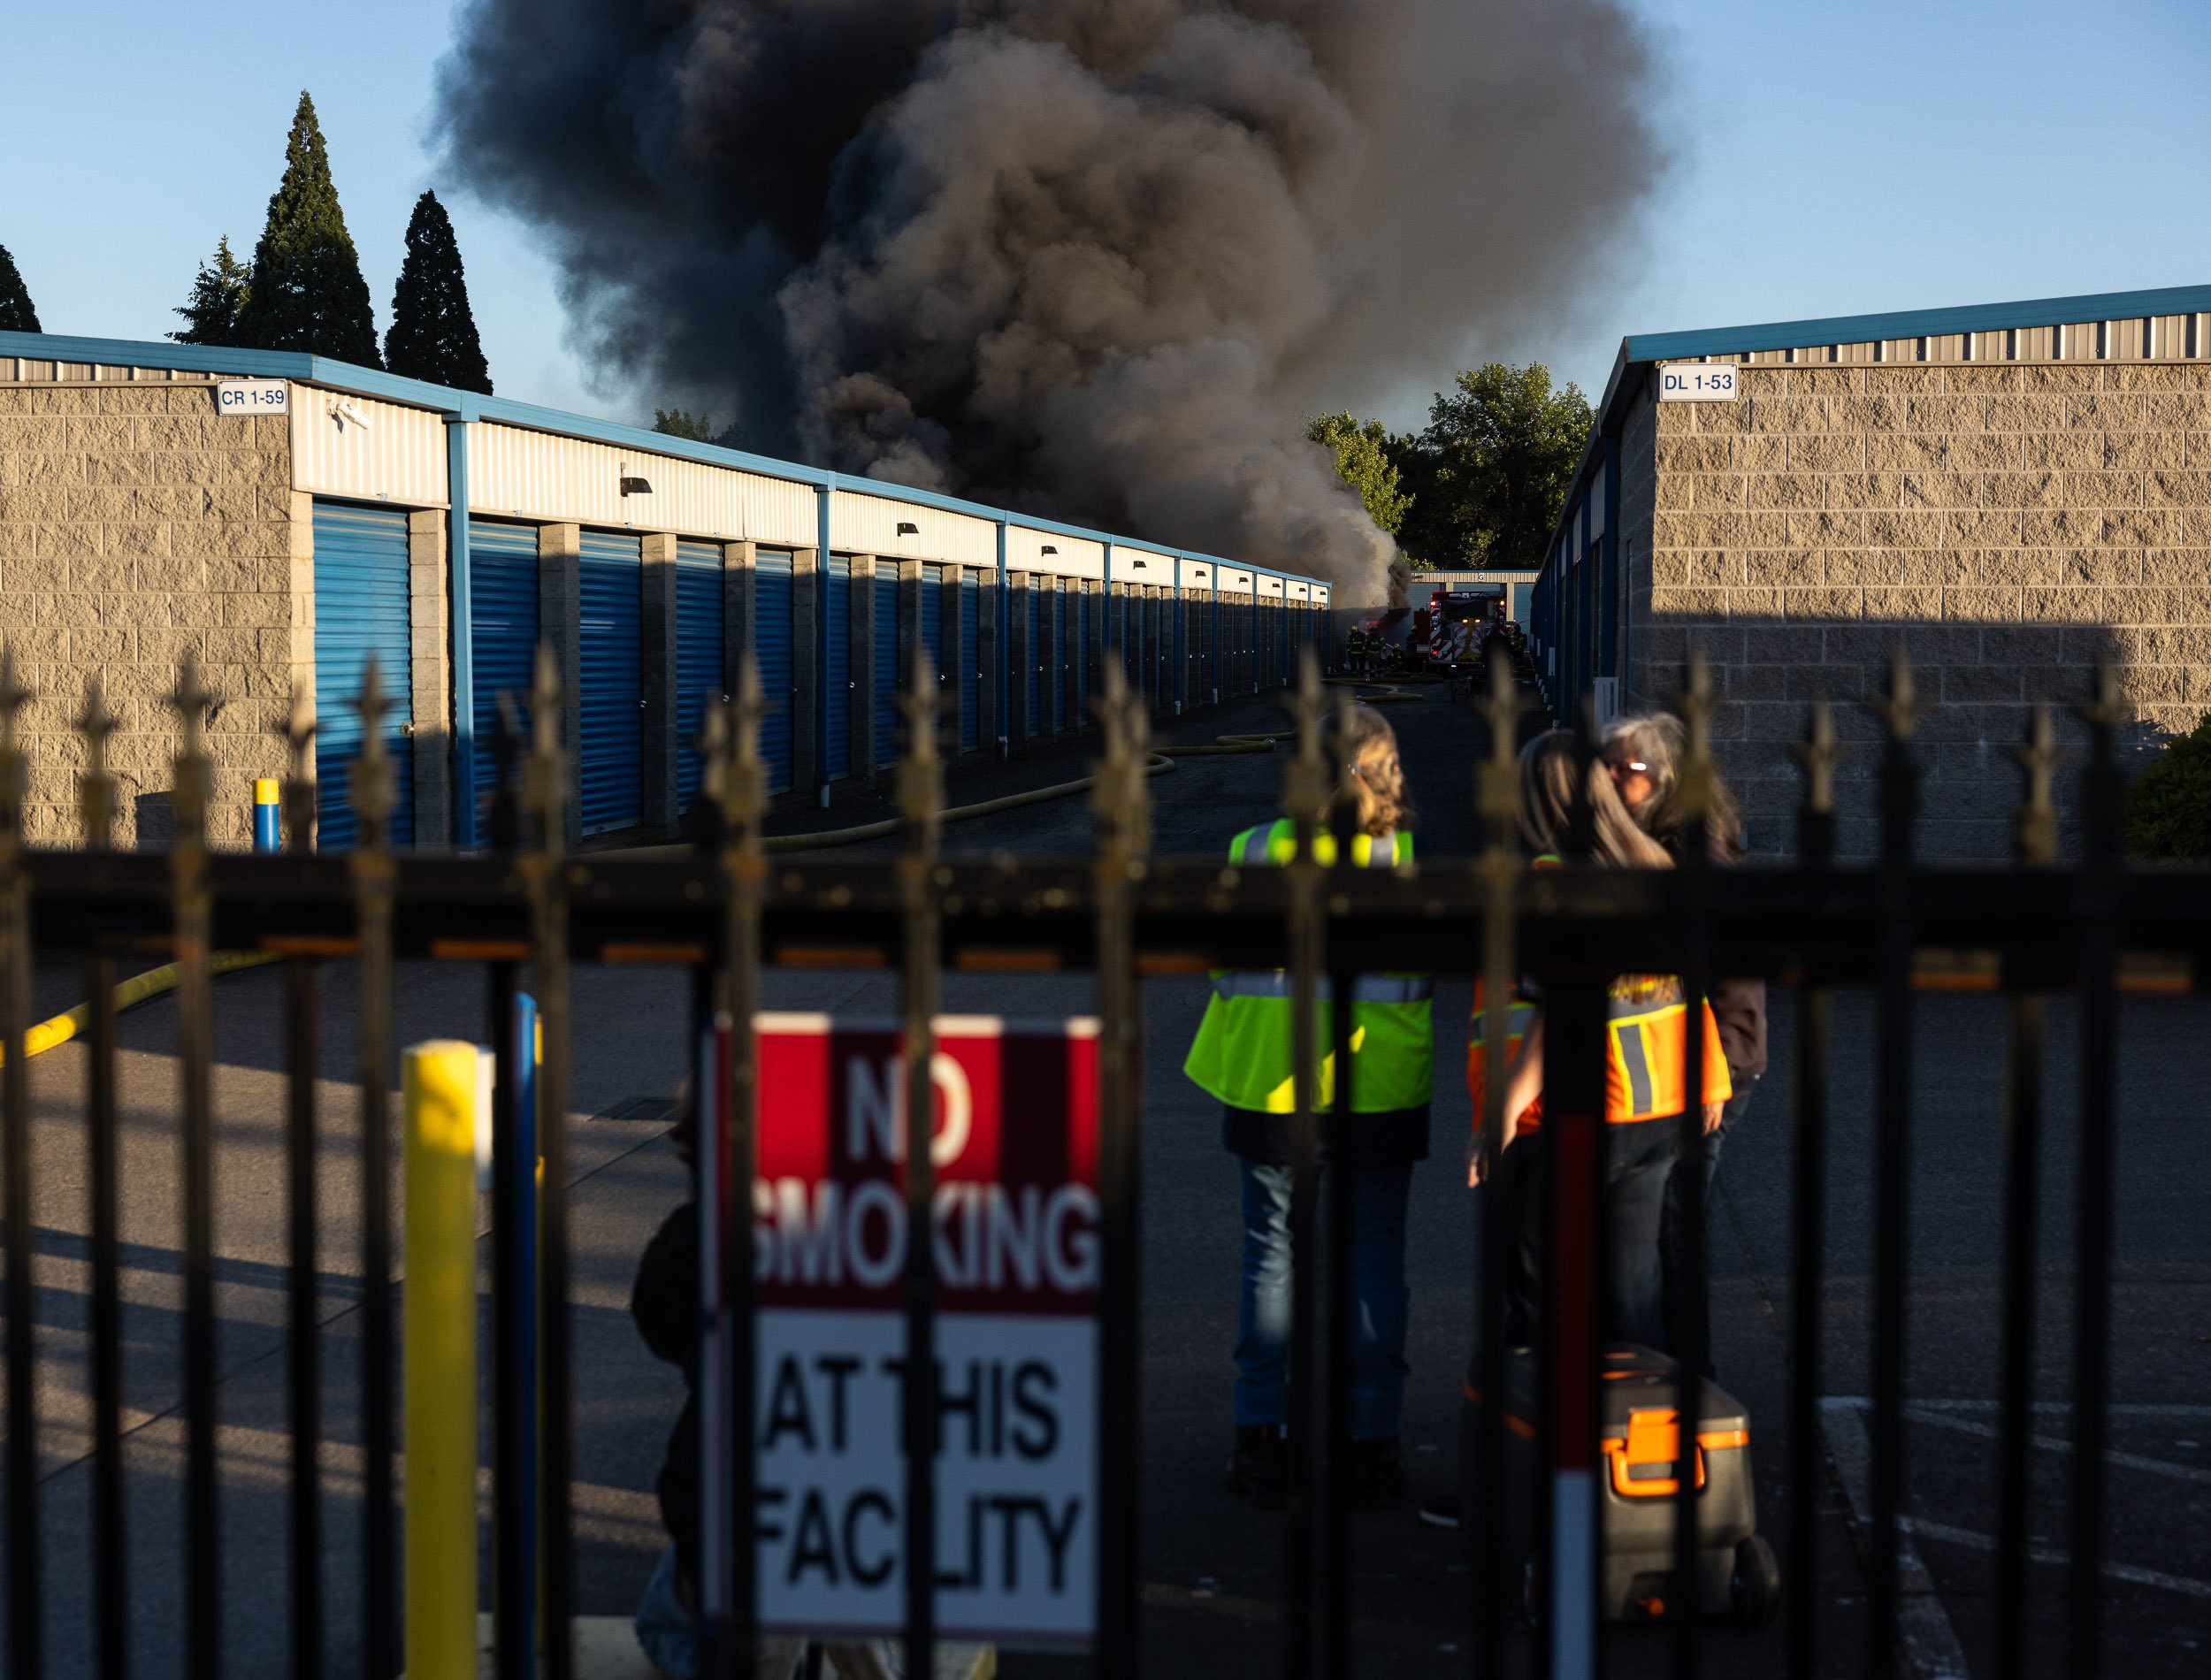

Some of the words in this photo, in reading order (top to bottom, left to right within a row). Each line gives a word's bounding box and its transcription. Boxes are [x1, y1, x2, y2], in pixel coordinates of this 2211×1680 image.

[221, 390, 245, 405] CR
[250, 389, 285, 405] 1-59
[1664, 374, 1688, 390] DL
[1695, 374, 1733, 390] 1-53
[847, 1050, 973, 1169] NO
[761, 1354, 864, 1454] AT
[753, 1487, 1083, 1598] FACITY
